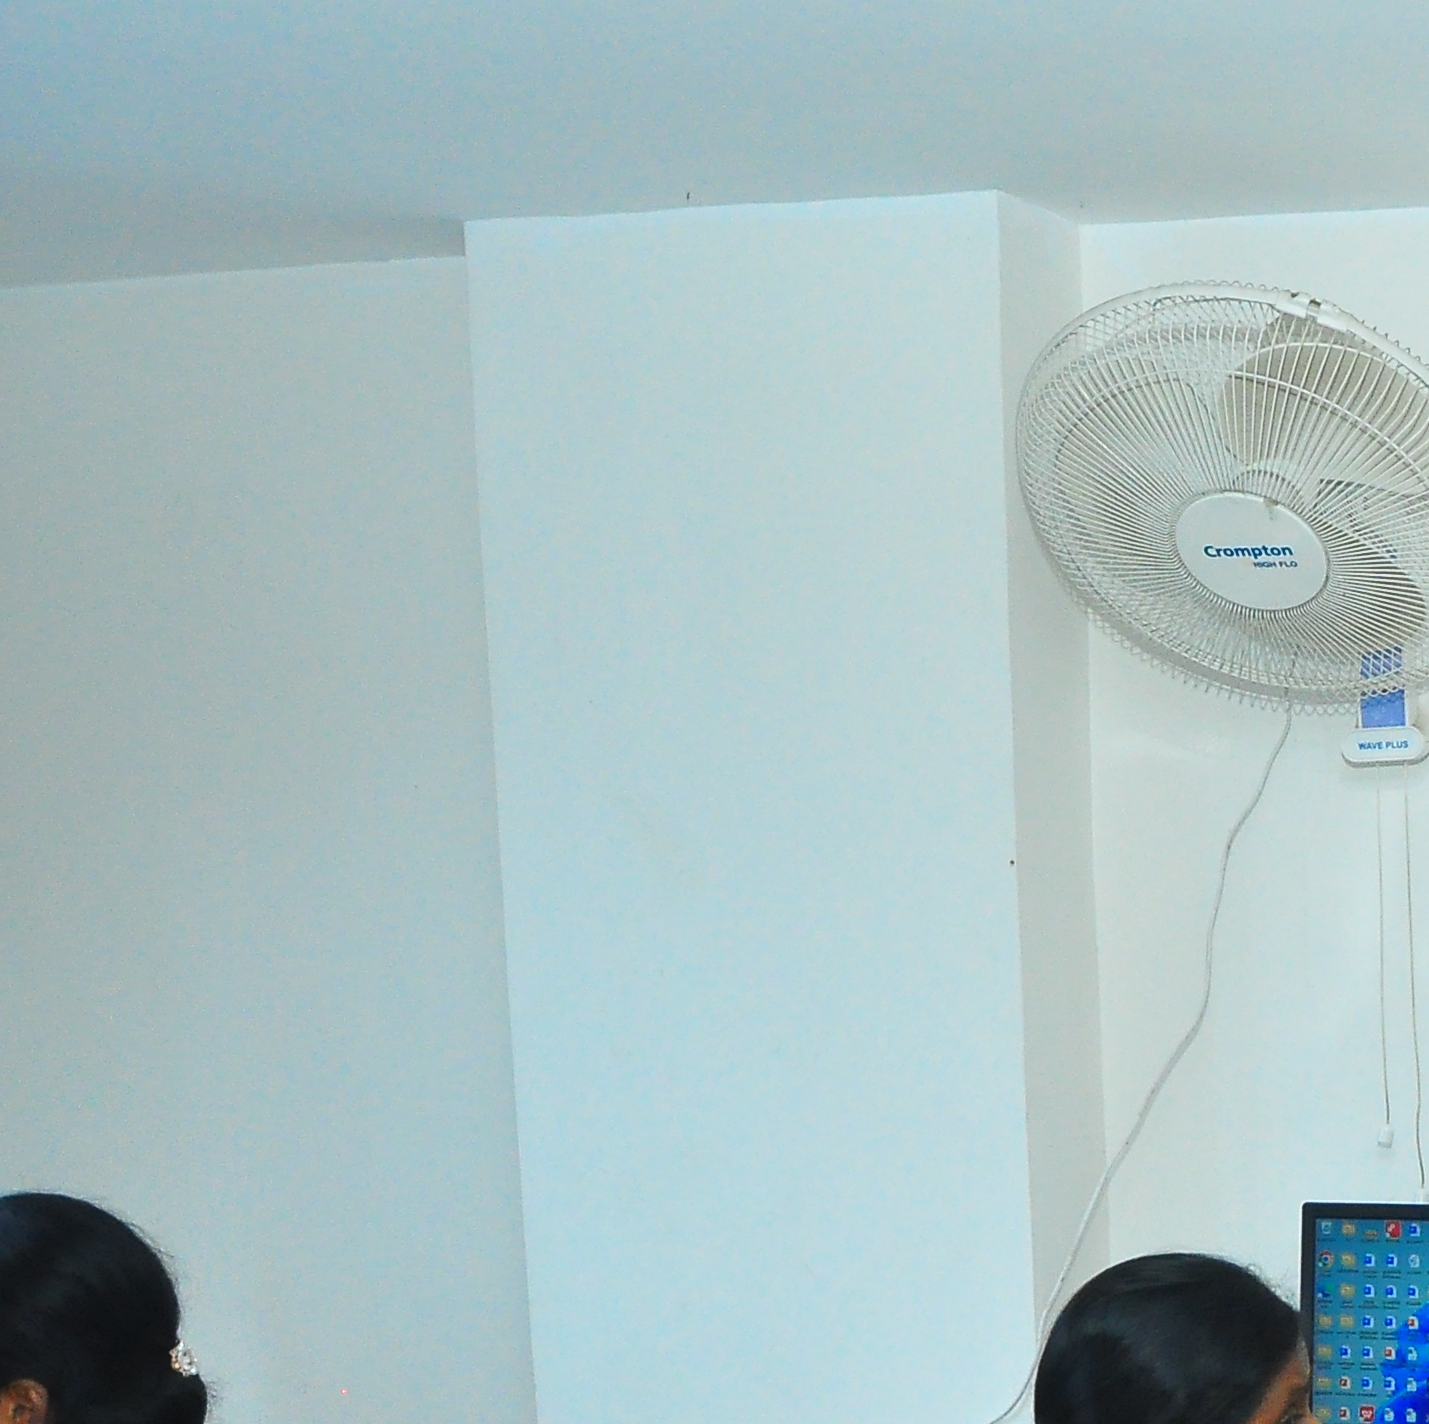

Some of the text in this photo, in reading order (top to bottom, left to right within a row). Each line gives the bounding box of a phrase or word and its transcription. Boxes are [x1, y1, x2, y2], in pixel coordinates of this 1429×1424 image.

[1203, 545, 1294, 560] Crompton
[1278, 560, 1298, 568] FLO
[1358, 740, 1409, 750] WAVE PLUS
